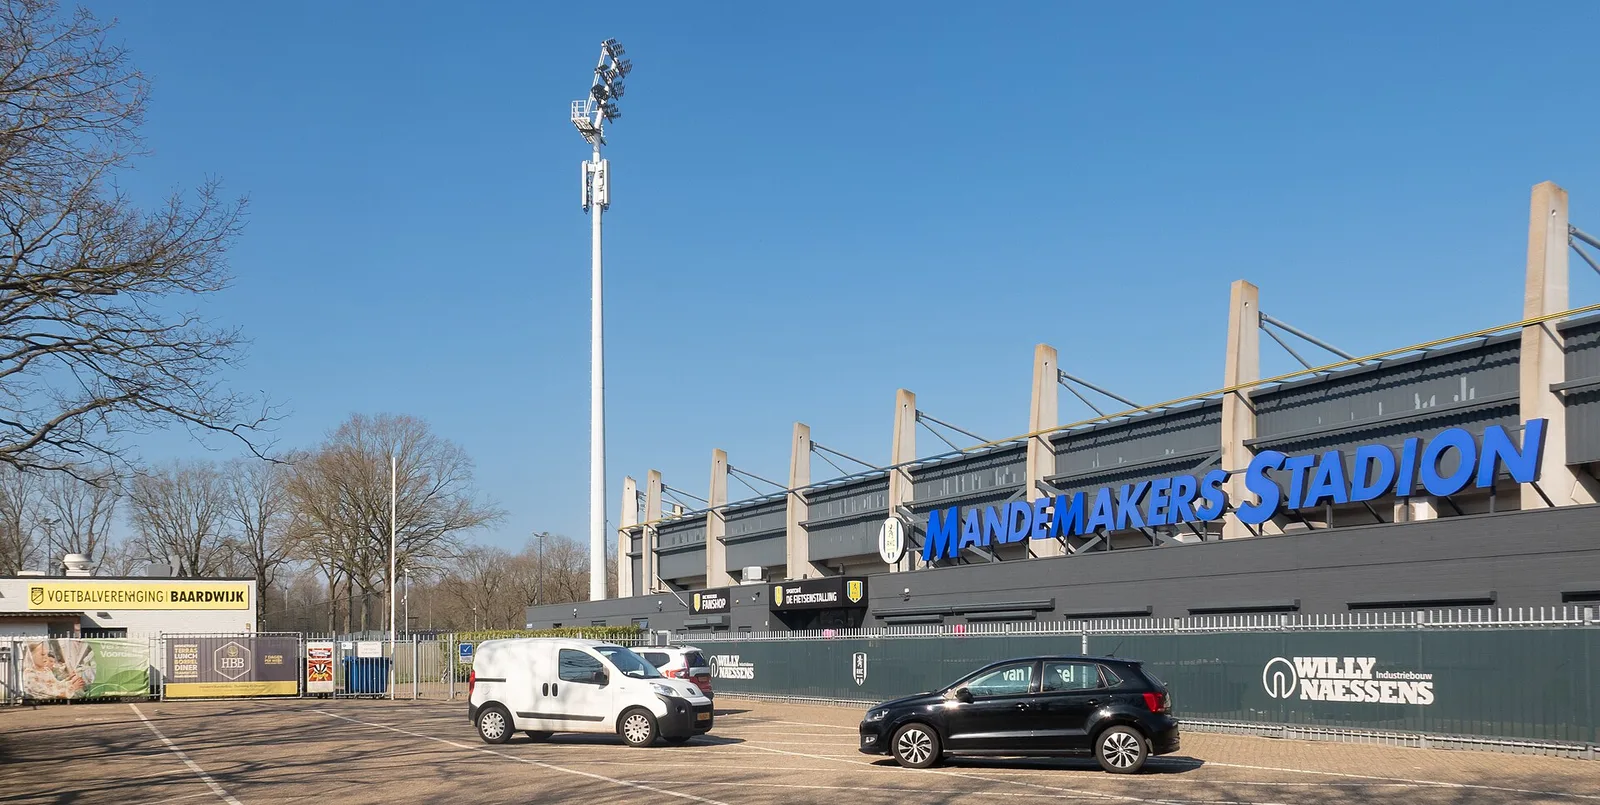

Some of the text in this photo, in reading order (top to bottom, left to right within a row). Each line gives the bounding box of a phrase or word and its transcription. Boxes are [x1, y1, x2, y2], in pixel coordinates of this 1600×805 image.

[923, 418, 1549, 562] MANDEMAKERS STADION
[47, 590, 244, 602] VOETBALVERENIGING BAARDWIJK
[786, 592, 838, 605] DE FIETSENSTALLING
[702, 598, 727, 610] FANSHOP
[221, 657, 245, 669] HBB
[717, 654, 740, 667] WILLY
[718, 666, 755, 679] NAESSENS
[1002, 668, 1024, 681] van
[1293, 657, 1376, 679] WILLY
[1375, 670, 1433, 680] Industriebouw
[1300, 679, 1435, 705] NAESSENS
